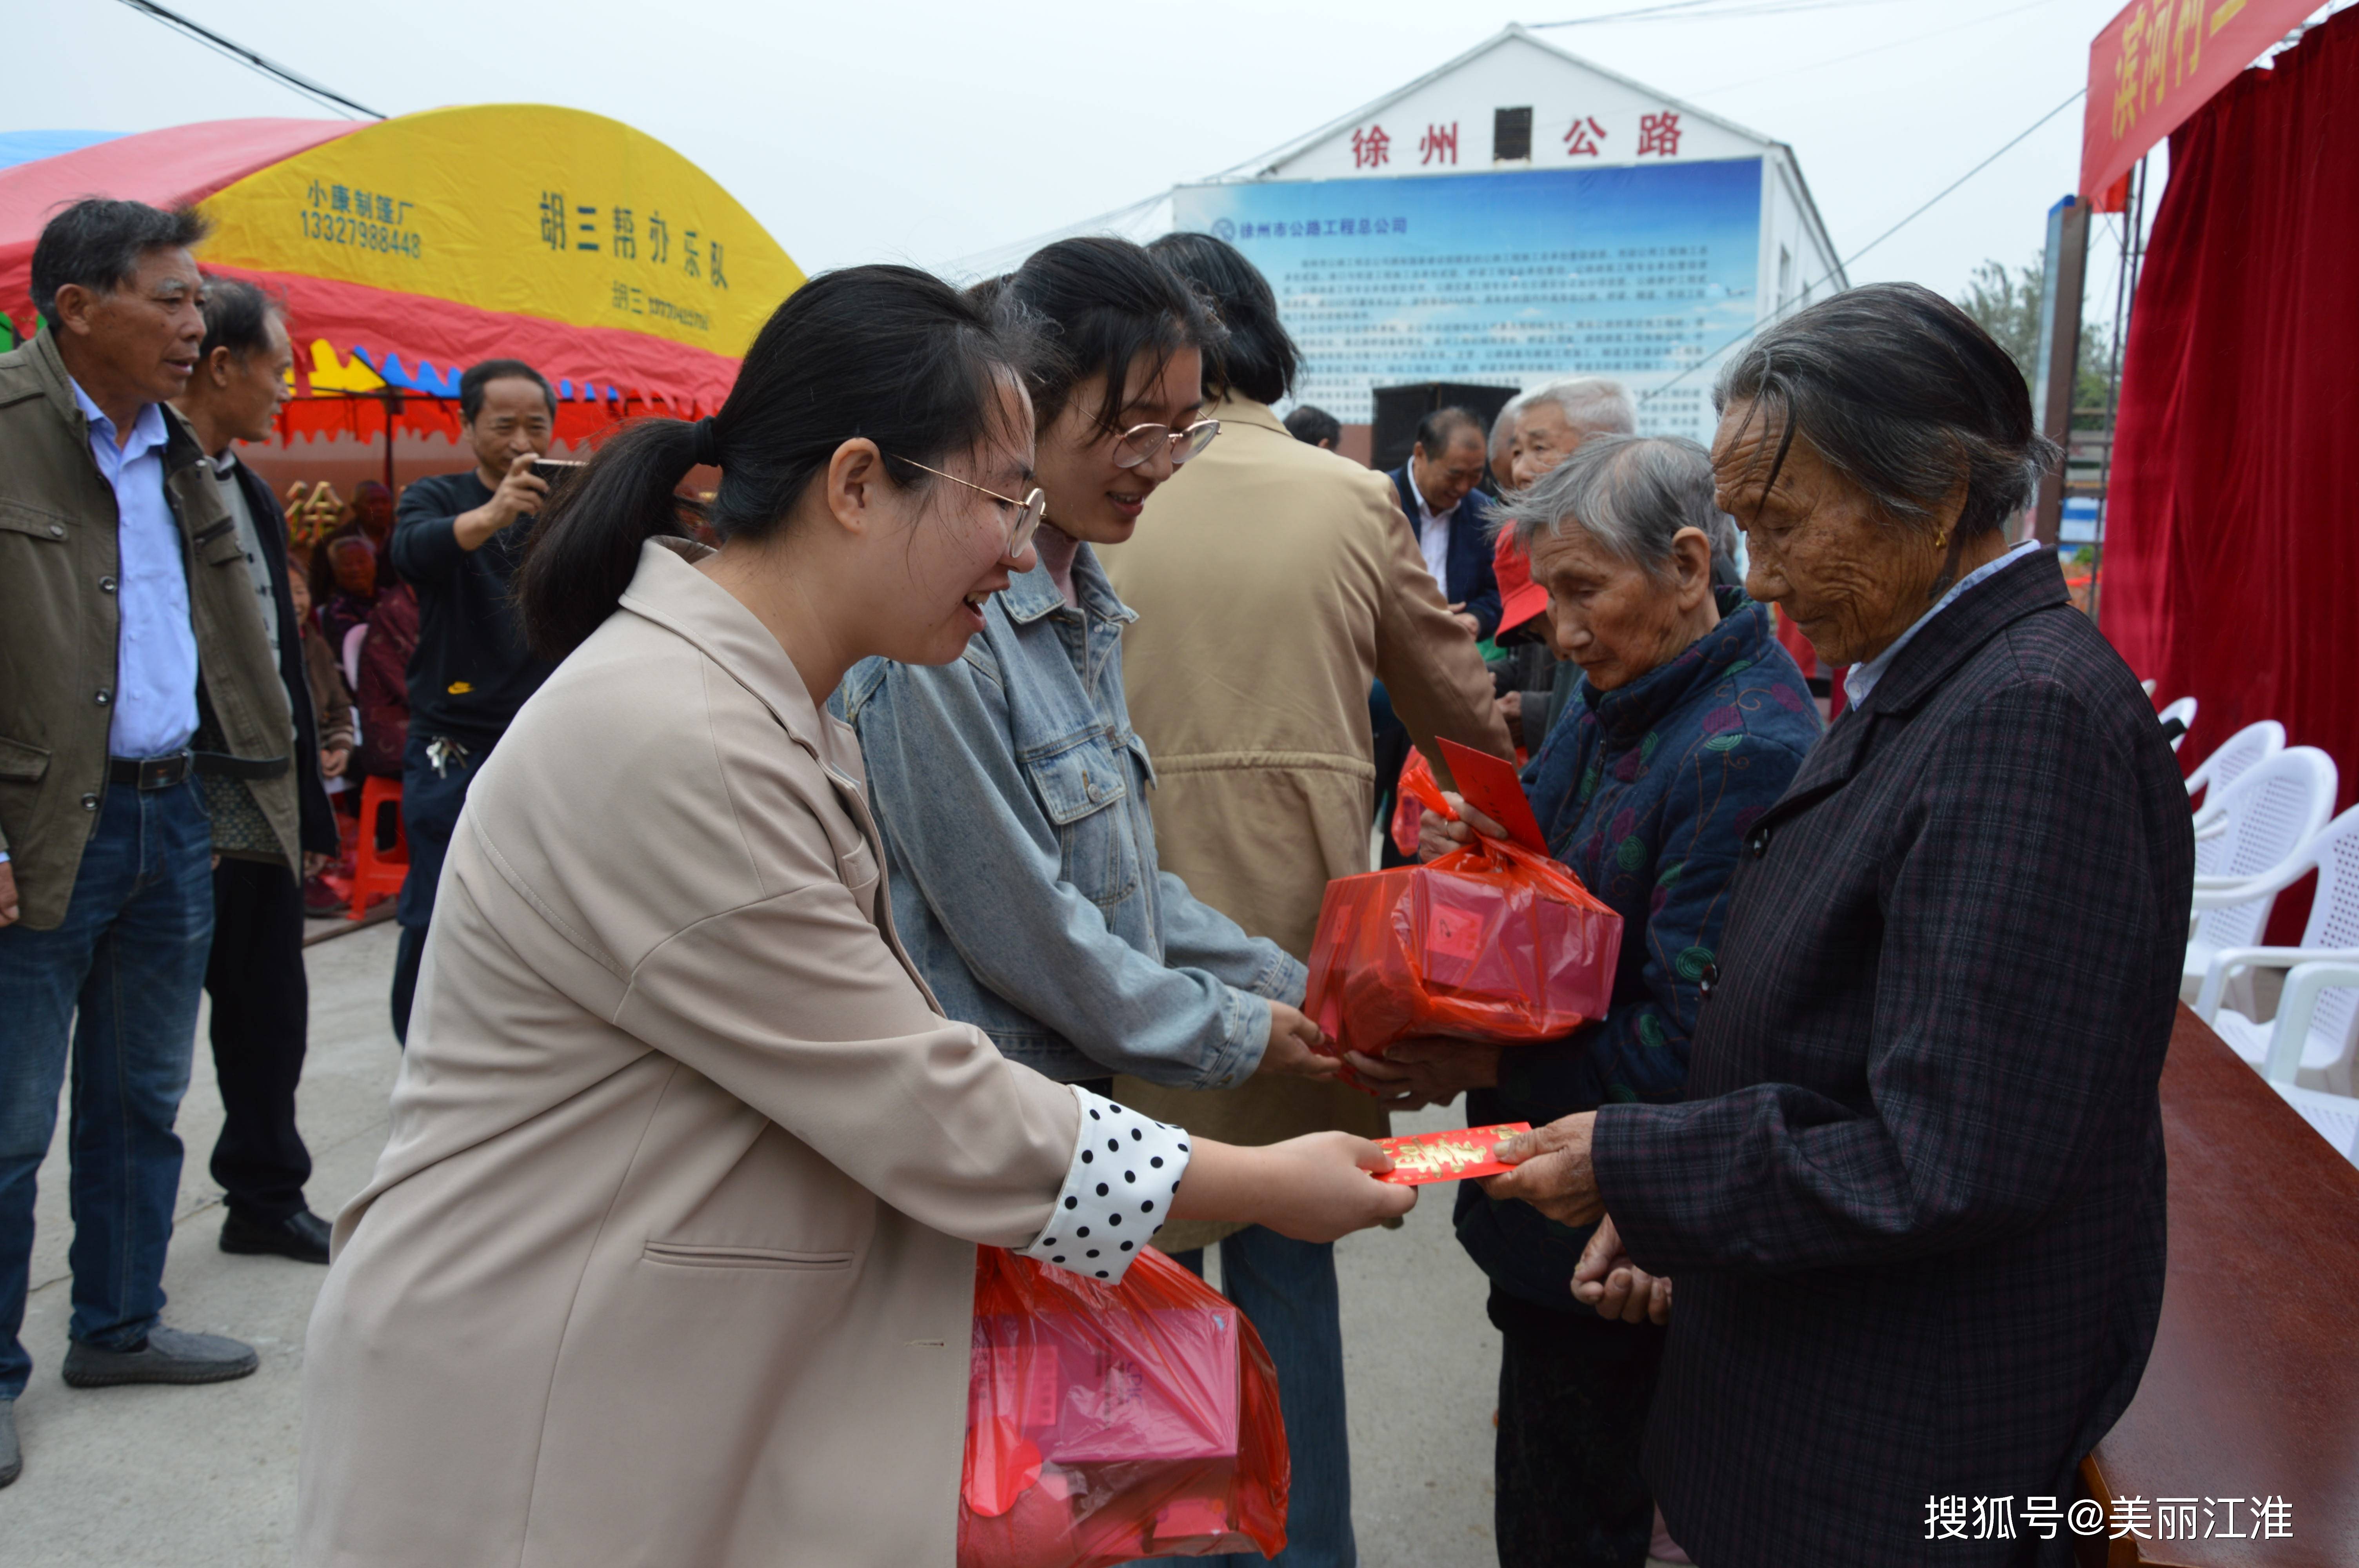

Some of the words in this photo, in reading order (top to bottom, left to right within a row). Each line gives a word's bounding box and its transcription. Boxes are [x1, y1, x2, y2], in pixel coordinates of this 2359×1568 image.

[1351, 111, 1683, 168] 徐州公路
[300, 209, 421, 260] 13327988448
[1239, 216, 1408, 240] 徐州市公路工程总公司
